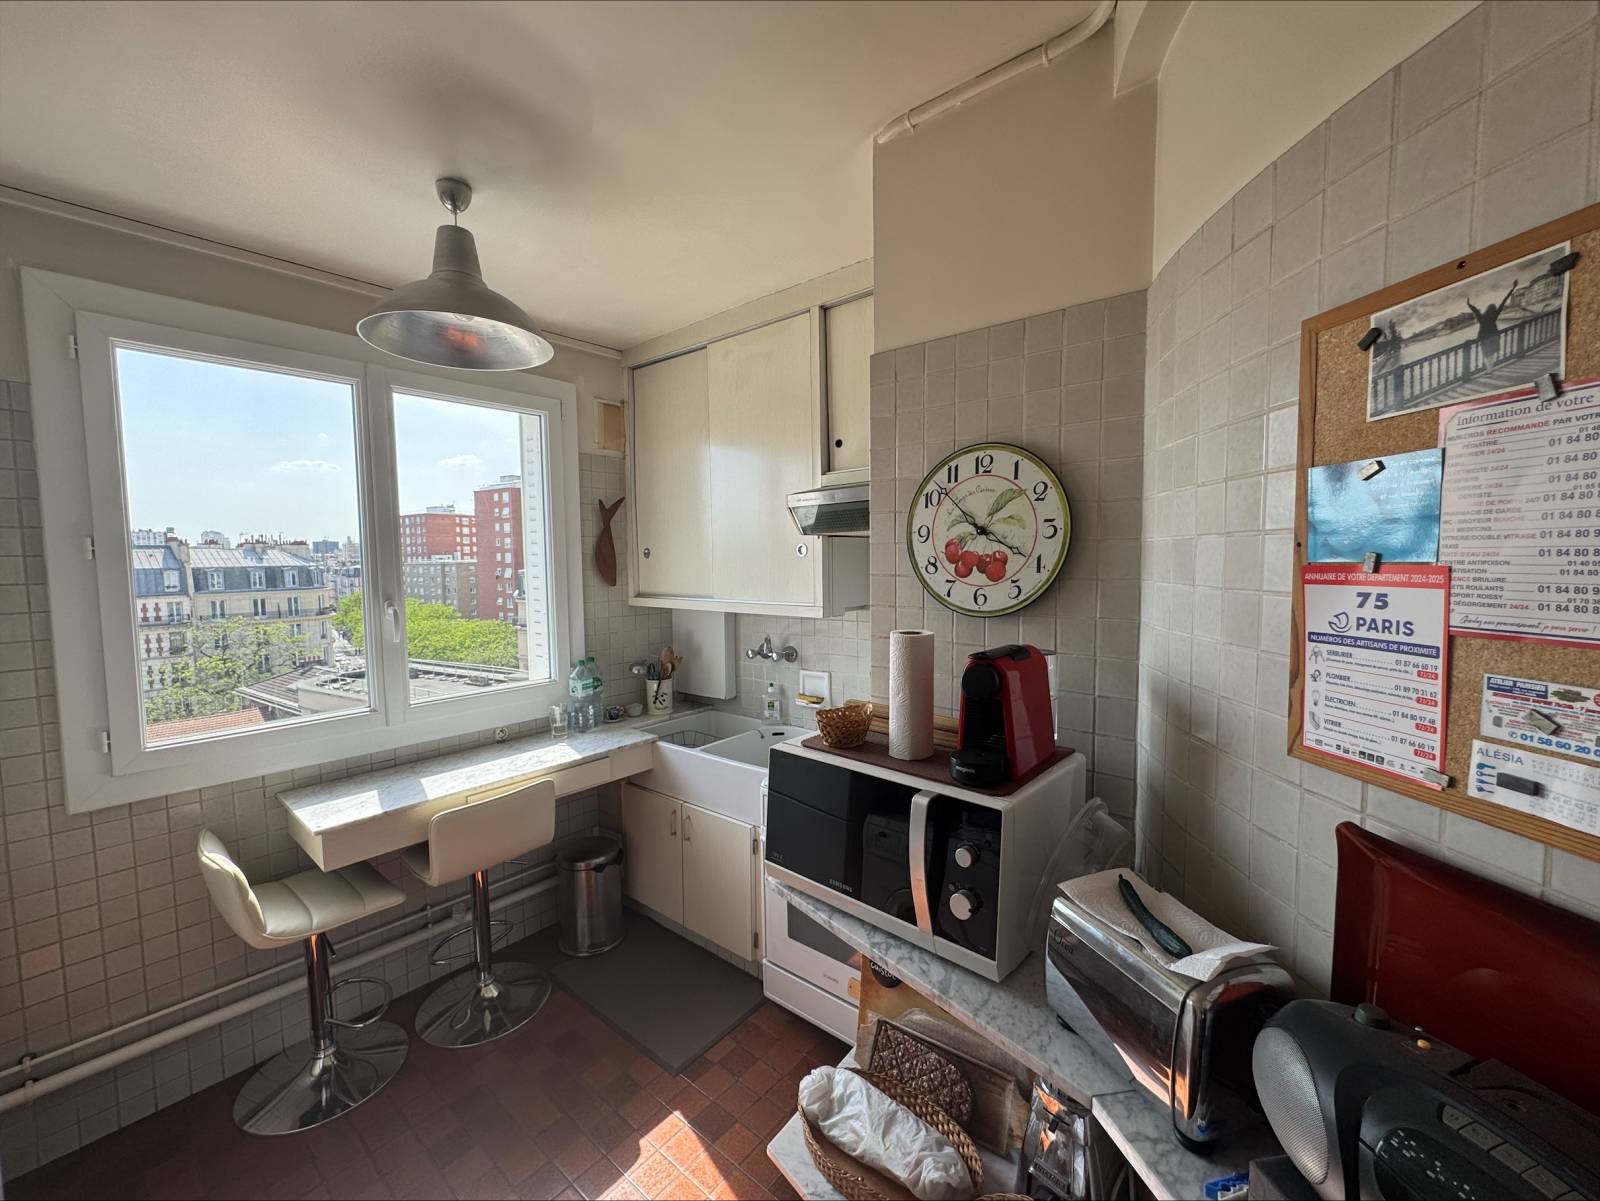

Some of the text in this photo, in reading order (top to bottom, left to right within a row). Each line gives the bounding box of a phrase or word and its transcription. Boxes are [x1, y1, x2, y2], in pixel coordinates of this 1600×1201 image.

[1457, 394, 1594, 426] Information de votre
[1552, 417, 1572, 425] PAR
[1548, 438, 1562, 447] 01
[1566, 435, 1581, 444] 84
[1584, 432, 1599, 442] 80
[975, 454, 994, 474] 12
[1547, 457, 1560, 465] 01
[1563, 454, 1578, 463] 84
[1582, 452, 1597, 461] 80
[947, 464, 958, 484] 11
[1013, 459, 1019, 480] 1
[1548, 471, 1597, 483] 01 84 80
[923, 489, 941, 509] 10
[1033, 481, 1048, 501] 2
[1543, 493, 1556, 501] 01
[1561, 492, 1575, 500] 84
[1578, 490, 1593, 499] 80
[1541, 512, 1554, 521] 01
[1559, 511, 1573, 520] 84
[1577, 510, 1591, 518] 80
[918, 525, 930, 543] 9
[1042, 519, 1057, 539] 3
[1557, 529, 1571, 538] 84
[1575, 529, 1590, 537] 80
[1538, 549, 1551, 557] 01
[1556, 548, 1570, 556] 84
[1574, 548, 1589, 556] 80
[925, 556, 939, 575] 8
[1027, 553, 1046, 573] 4
[1305, 573, 1336, 581] ANNUAIRE
[1410, 574, 1444, 583] 2024-2025
[945, 579, 956, 598] 7
[973, 588, 987, 606] 6
[1008, 578, 1022, 599] 5
[1538, 585, 1552, 593] 01
[1555, 585, 1569, 594] 84
[1574, 585, 1588, 595] 80
[1592, 587, 1600, 595] 9
[1356, 592, 1389, 610] 75
[1538, 603, 1551, 611] 01
[1555, 604, 1570, 613] 84
[1574, 604, 1588, 614] 80
[1592, 606, 1600, 614] 8
[1356, 617, 1415, 637] PARIS
[1310, 633, 1341, 644] NUMÉROS
[1343, 638, 1355, 646] DES
[1356, 639, 1387, 650] ARTISANS
[1400, 645, 1437, 656] PROXIMITÉ
[1431, 664, 1438, 672] 19
[1395, 684, 1401, 692] 01
[1412, 687, 1420, 695] 70
[1410, 713, 1417, 721] 80
[1391, 735, 1398, 743] 01
[1400, 736, 1407, 745] 87
[1409, 739, 1416, 747] 66
[1417, 741, 1425, 749] 60
[1427, 743, 1435, 752] 19
[1520, 733, 1533, 742] 01
[1537, 737, 1553, 747] 58
[1555, 741, 1571, 750] 60
[1574, 745, 1590, 755] 20
[1477, 747, 1524, 766] ALÉSIA
